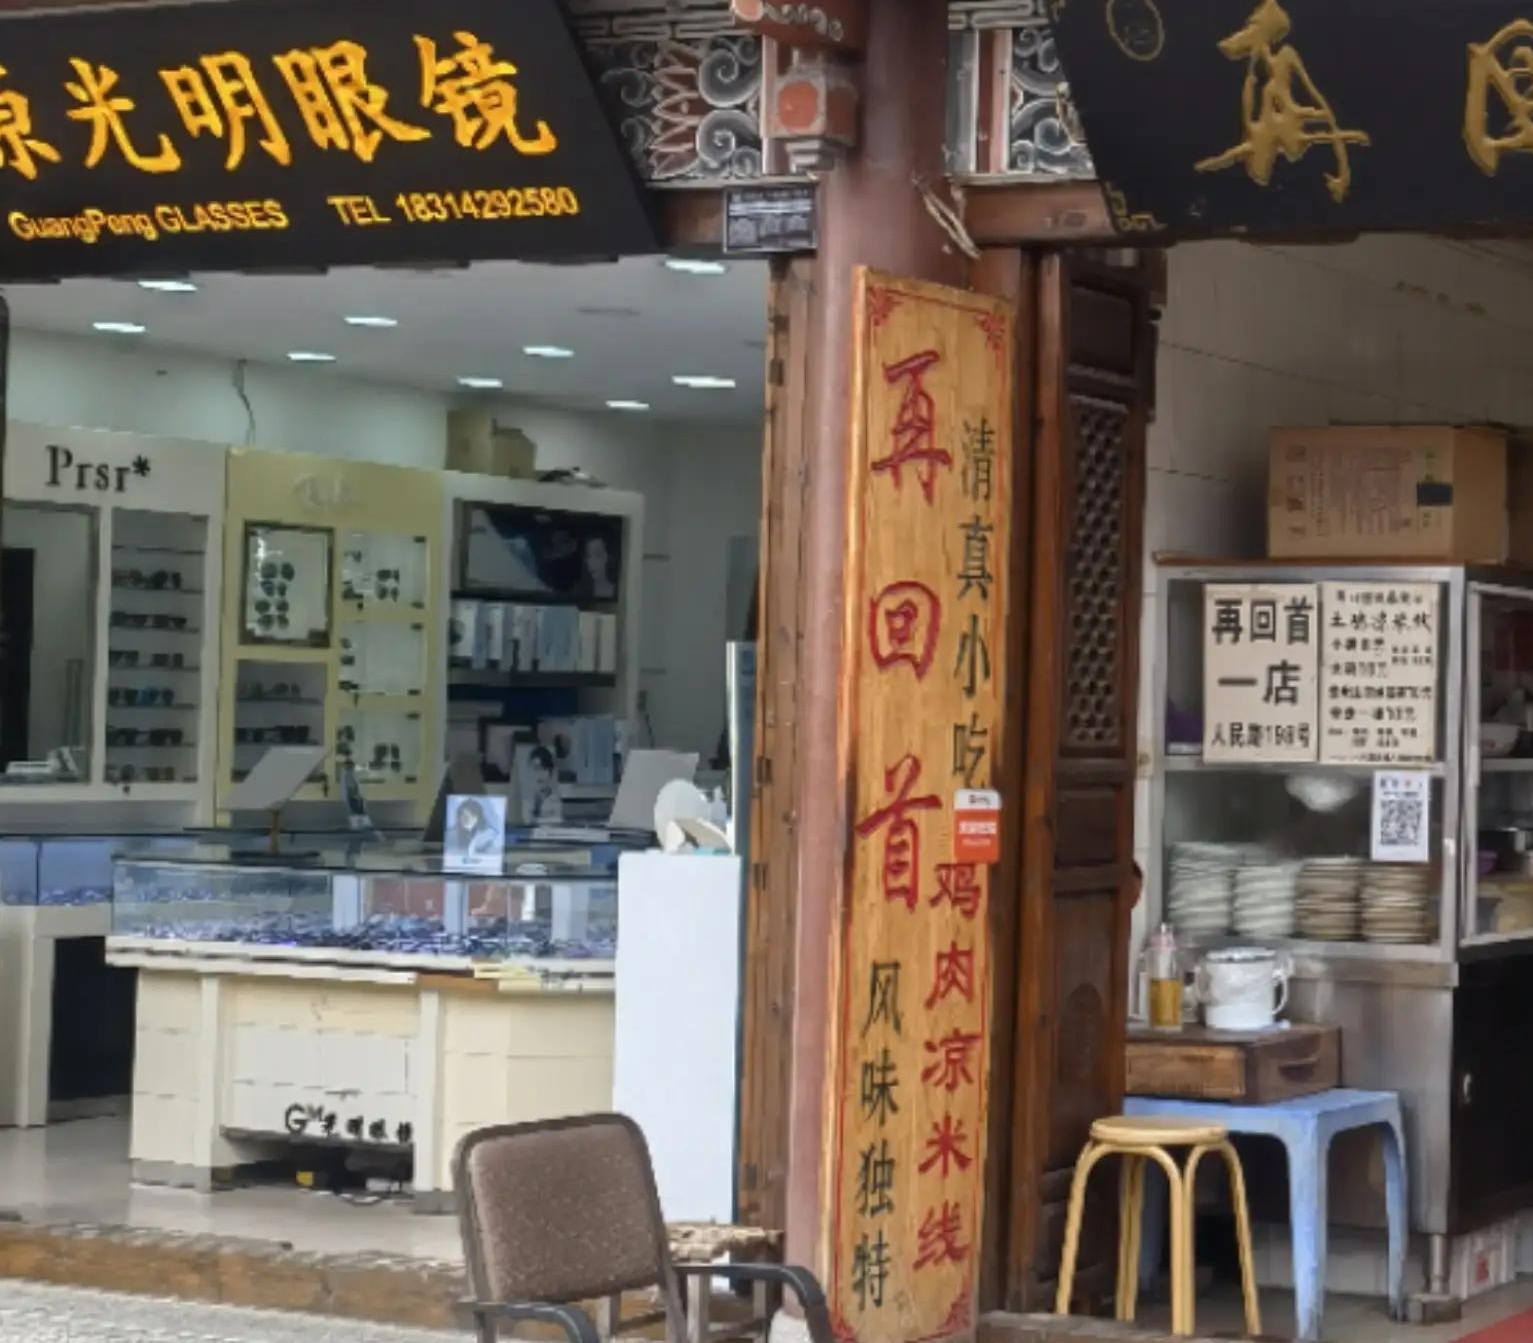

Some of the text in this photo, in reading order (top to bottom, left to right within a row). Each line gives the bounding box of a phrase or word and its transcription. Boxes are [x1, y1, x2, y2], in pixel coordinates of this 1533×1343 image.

[7, 185, 580, 244] GuangPeng GLASSES TEL 18314292580
[855, 349, 953, 914] 再回首
[952, 417, 996, 790] 清真小吃
[1211, 596, 1314, 646] 再回首
[1217, 659, 1301, 706] 一店
[851, 959, 903, 1312] 风味独特
[912, 860, 984, 1271] 鸡肉凉米线
